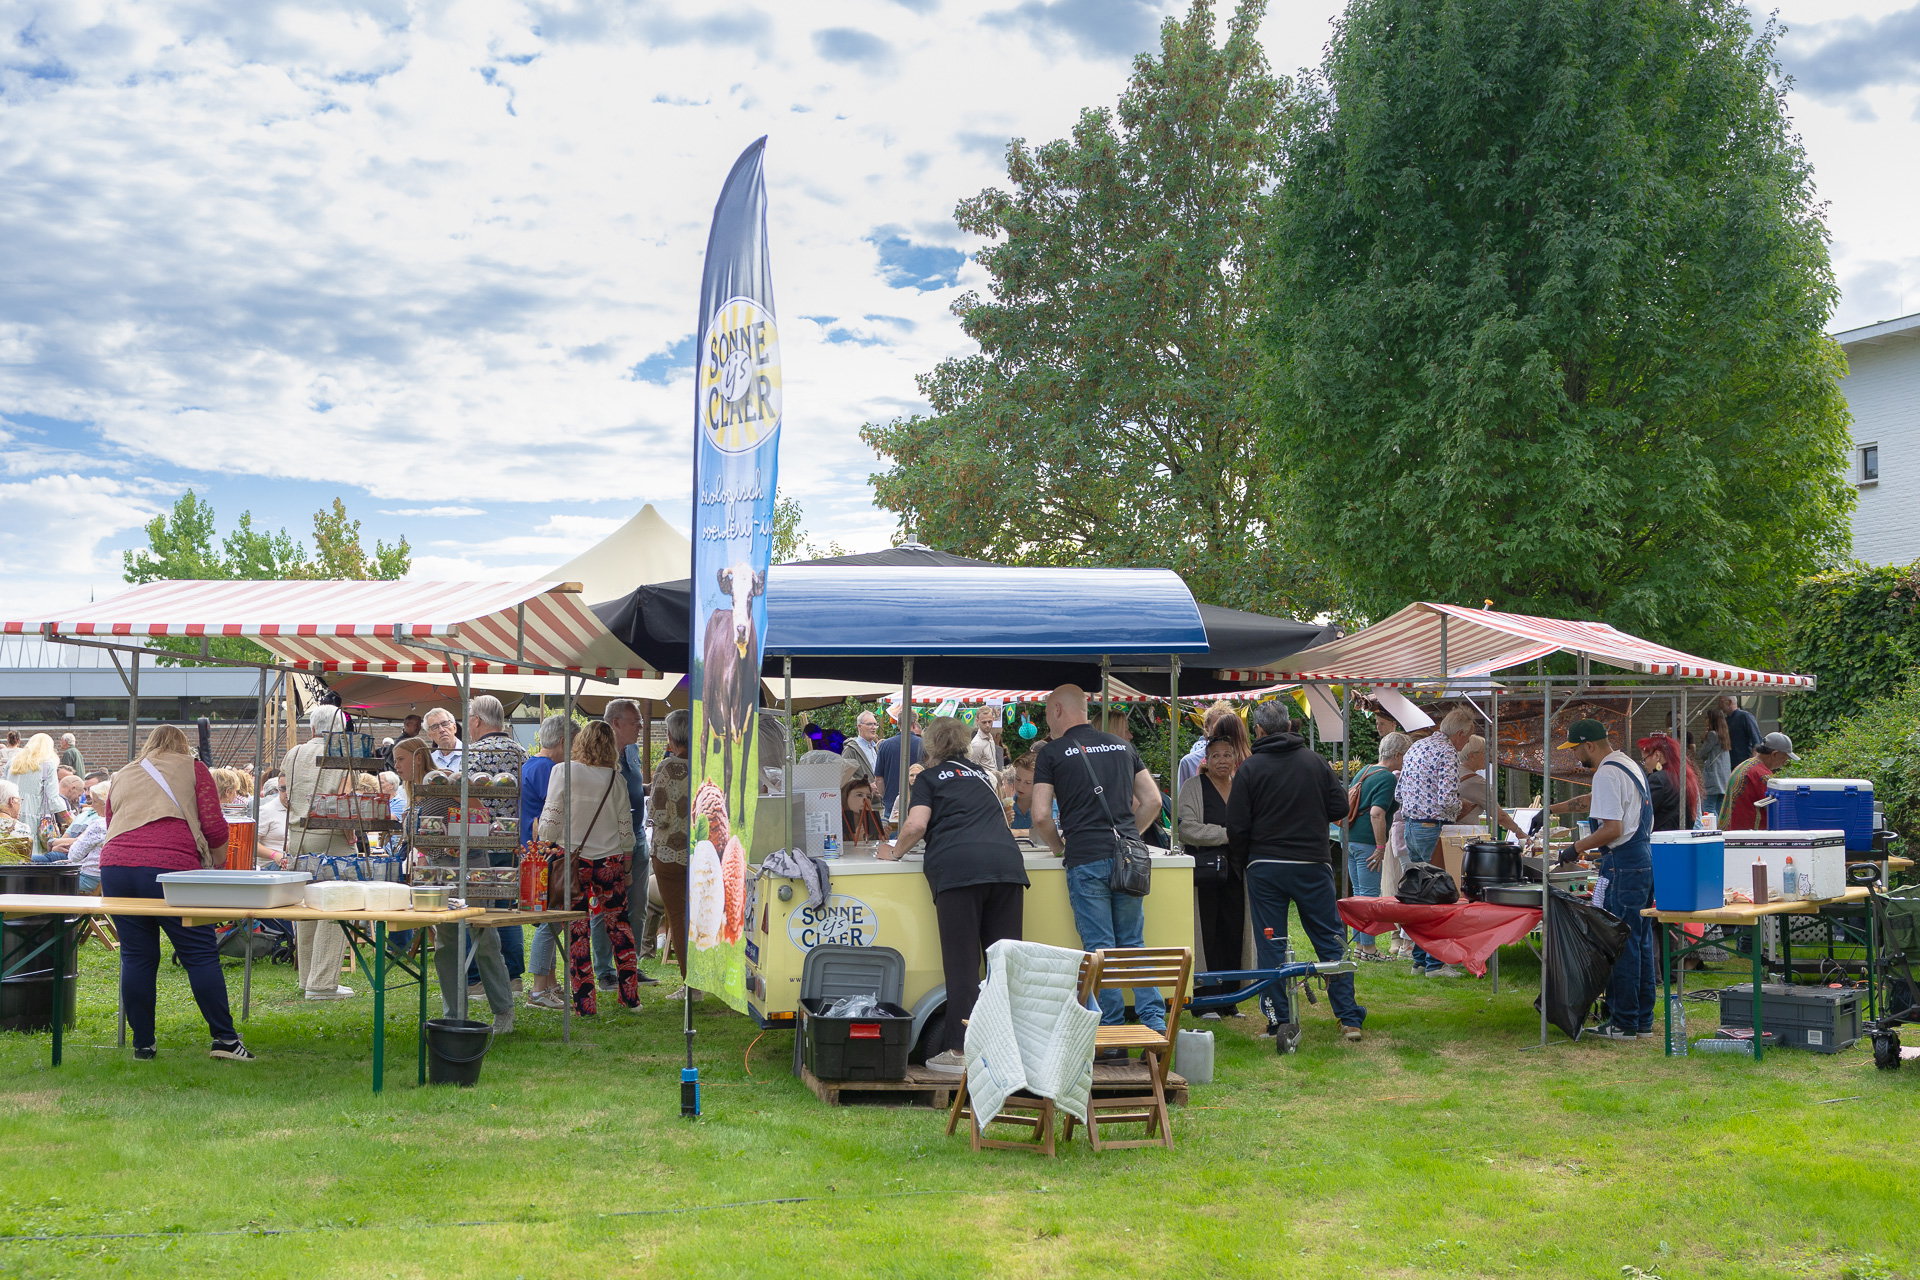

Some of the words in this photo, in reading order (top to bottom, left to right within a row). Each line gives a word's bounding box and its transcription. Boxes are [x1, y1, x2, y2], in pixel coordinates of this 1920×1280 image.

[710, 320, 770, 379] SONNE
[725, 353, 748, 401] ijs
[708, 374, 776, 431] CLAER
[1064, 746, 1080, 757] de
[1081, 743, 1127, 754] tamboer
[938, 770, 955, 780] de
[801, 905, 864, 926] SONNE
[822, 916, 846, 937] ijs
